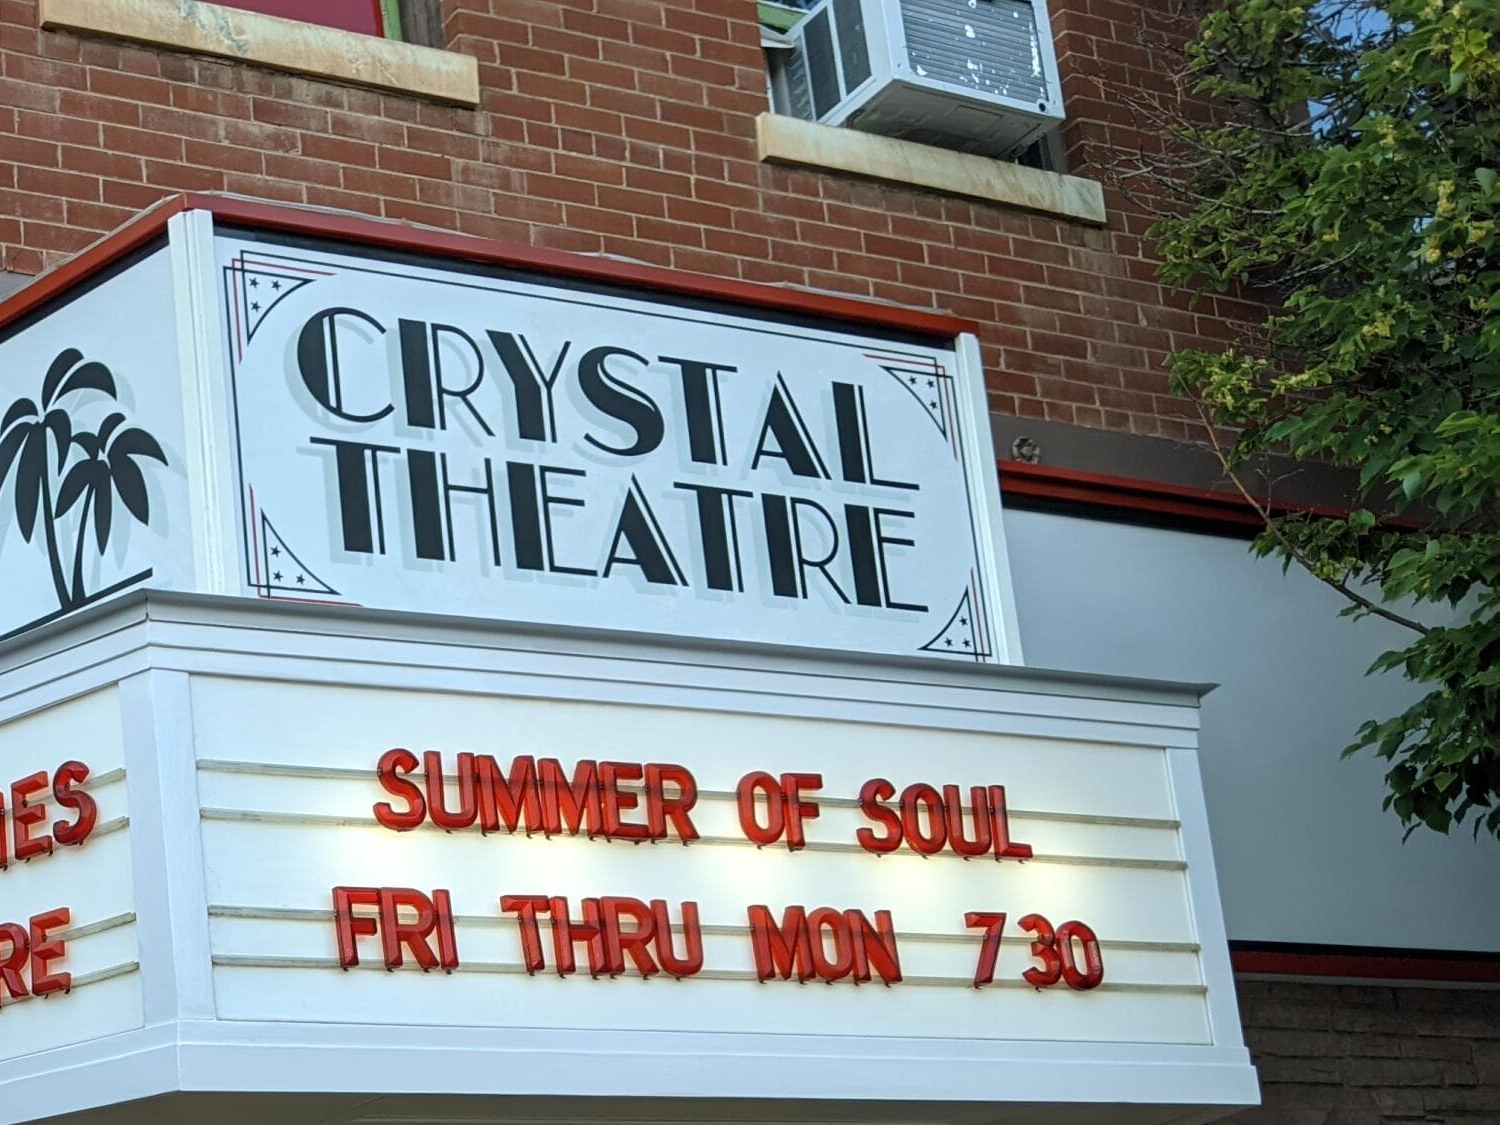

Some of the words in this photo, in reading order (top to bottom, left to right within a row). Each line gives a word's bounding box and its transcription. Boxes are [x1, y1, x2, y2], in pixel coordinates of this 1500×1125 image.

[296, 306, 919, 490] CRYSTAL
[309, 436, 929, 612] THEATRE
[372, 748, 700, 846] SUMMER
[737, 769, 823, 851] OF
[855, 777, 1034, 861] SOUL
[331, 885, 455, 972] FRI
[499, 894, 705, 978] THRU
[748, 903, 902, 985] MON
